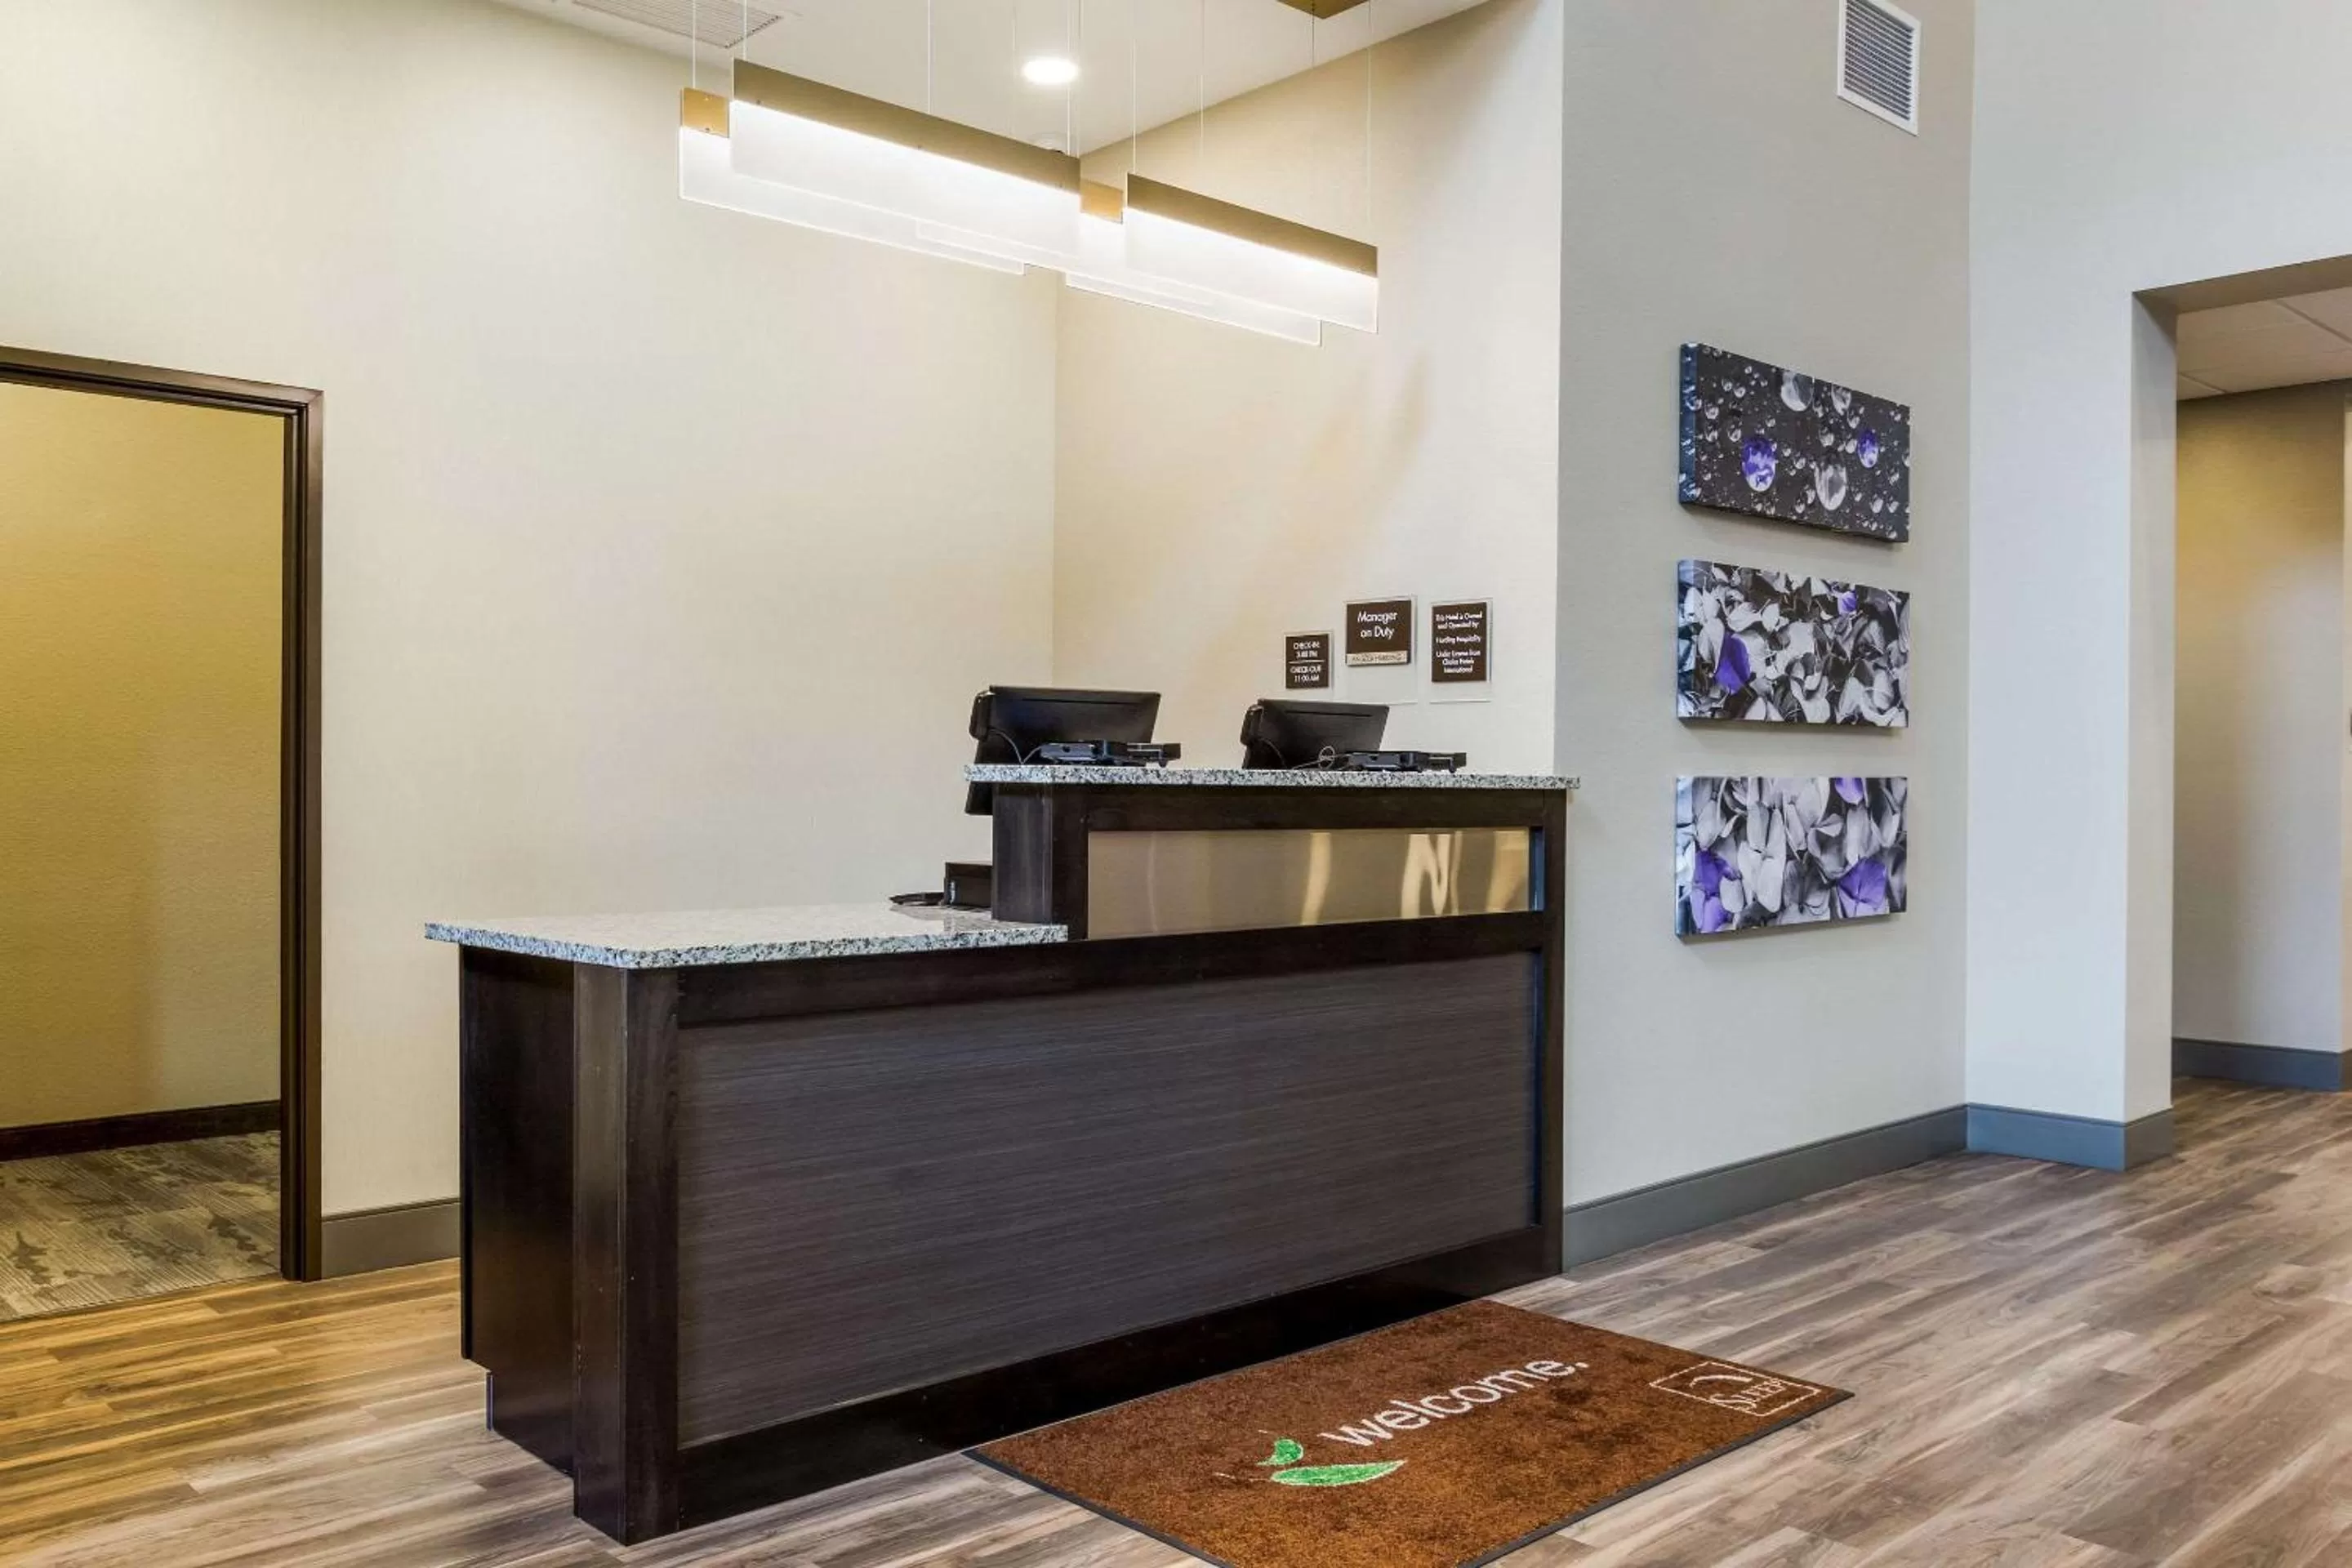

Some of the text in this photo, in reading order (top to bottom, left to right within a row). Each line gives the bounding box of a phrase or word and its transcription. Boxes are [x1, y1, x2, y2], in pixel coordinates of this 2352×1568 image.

[1357, 611, 1397, 624] Manager
[1360, 626, 1395, 640] on Duty
[1316, 1360, 1589, 1446] welcome.
